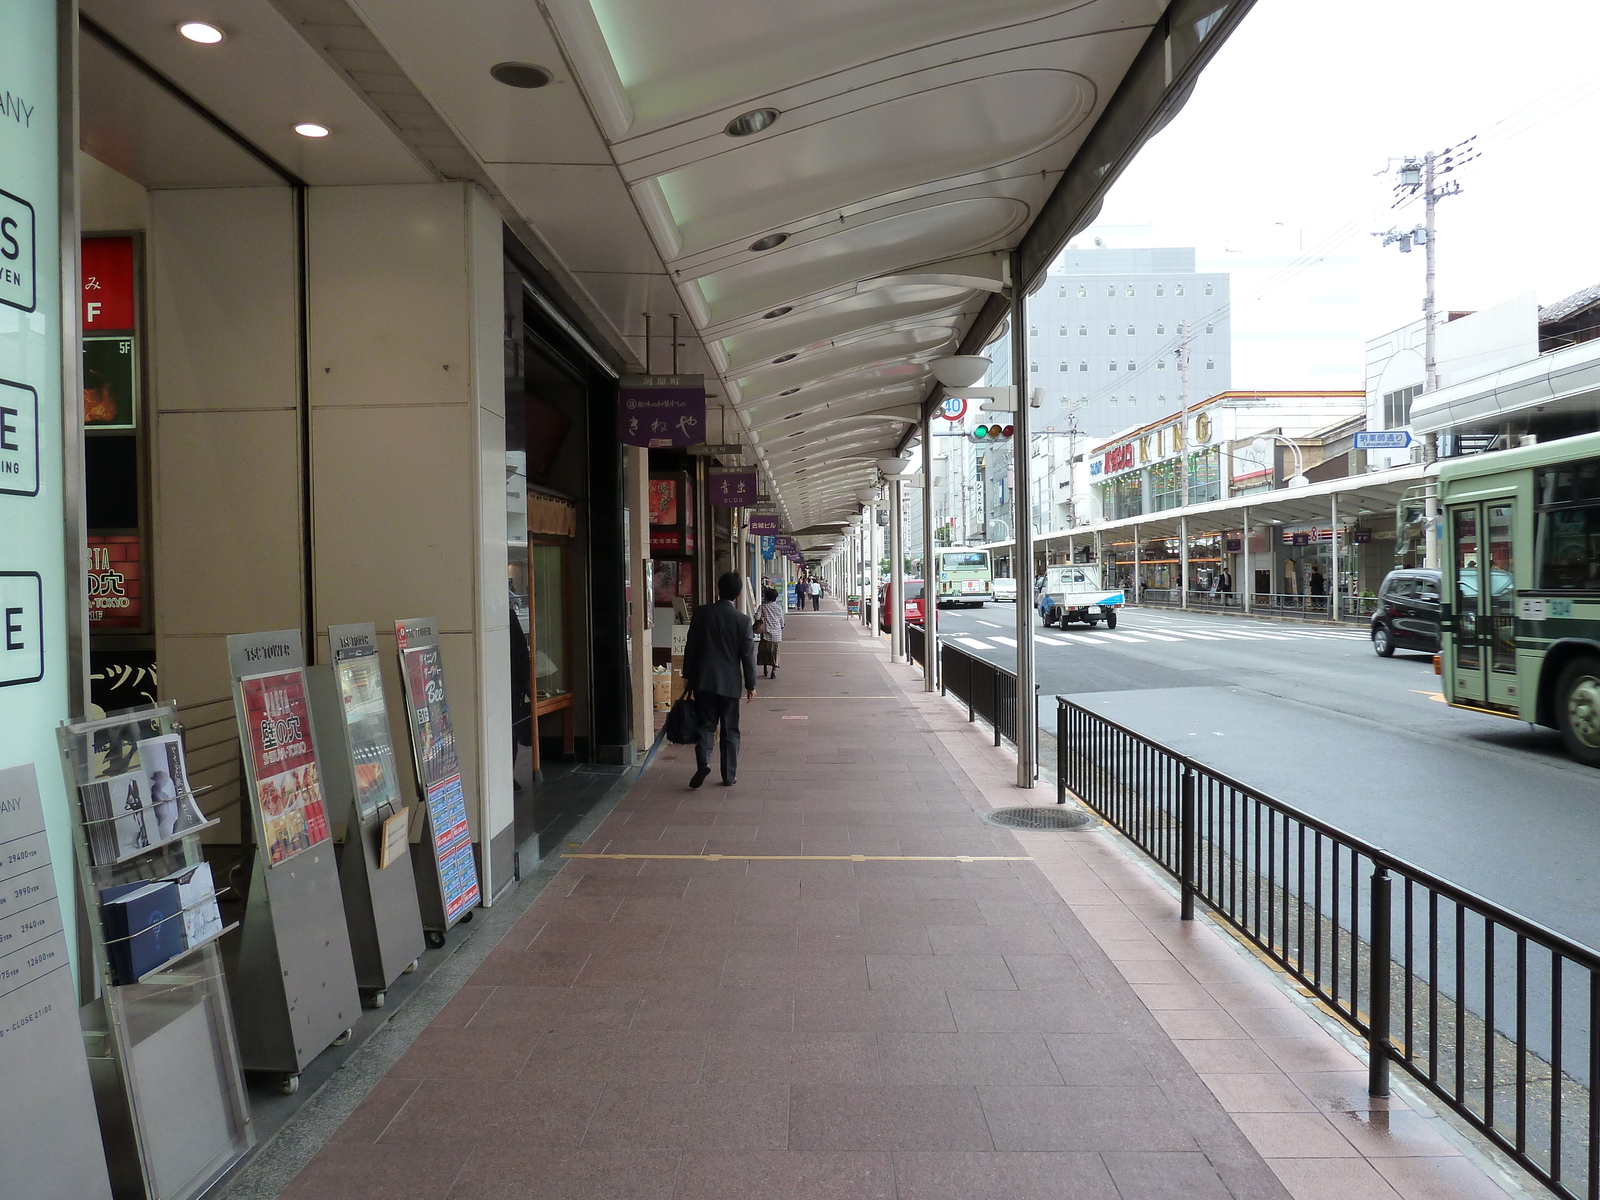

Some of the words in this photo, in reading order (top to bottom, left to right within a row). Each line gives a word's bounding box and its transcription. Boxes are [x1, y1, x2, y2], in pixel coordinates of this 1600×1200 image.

[1, 216, 19, 260] S
[87, 302, 101, 322] F
[119, 342, 131, 355] 5F
[945, 397, 961, 413] 40
[1, 406, 19, 452] E
[1139, 411, 1212, 464] KING
[6, 606, 24, 651] E
[425, 680, 444, 704] Bee
[261, 713, 302, 750] 壁の穴
[12, 1014, 34, 1031] CLOSE
